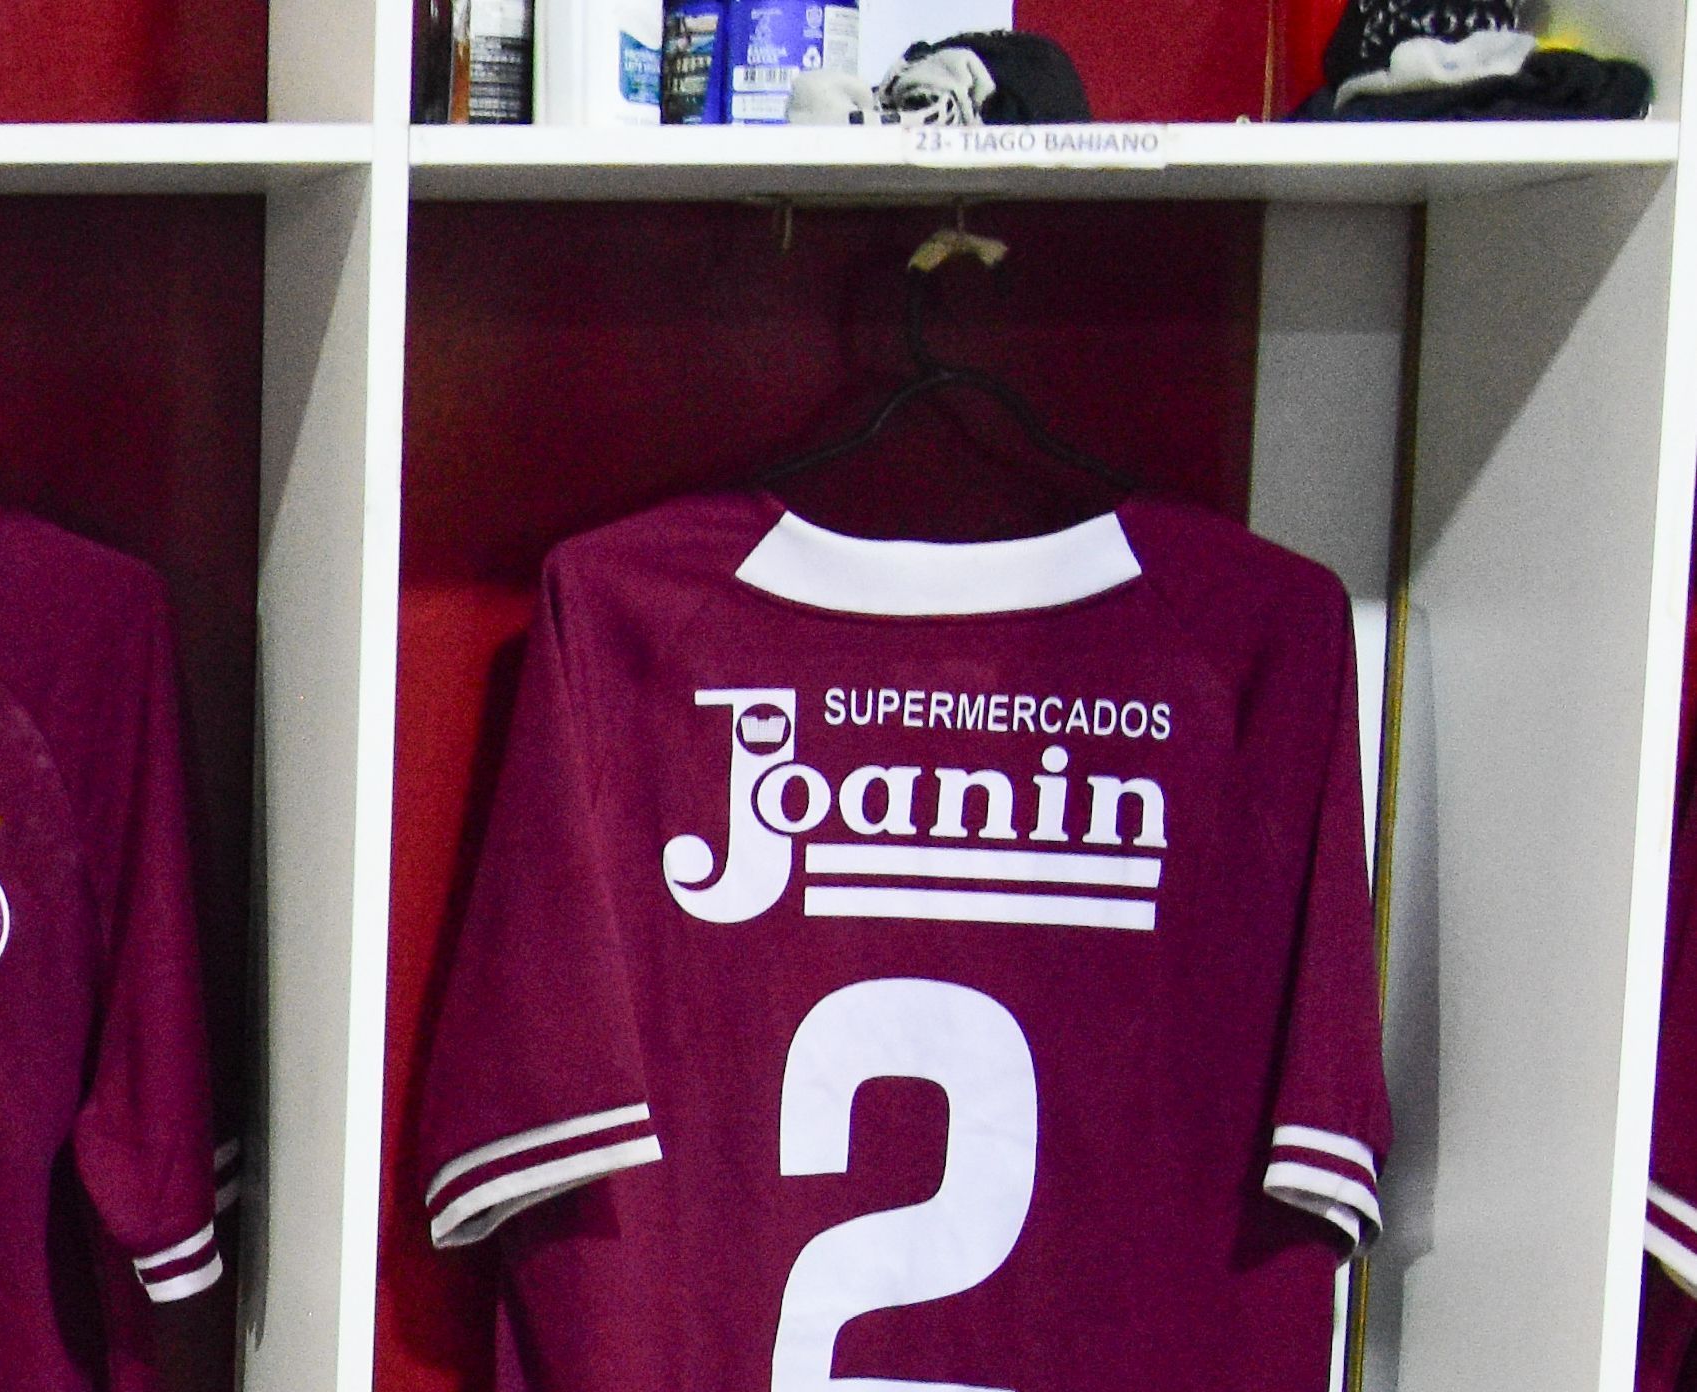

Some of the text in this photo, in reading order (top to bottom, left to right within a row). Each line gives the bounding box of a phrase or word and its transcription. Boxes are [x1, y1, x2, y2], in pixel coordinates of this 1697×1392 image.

[962, 131, 1036, 152] TIAGO
[1044, 132, 1159, 153] BAHIANO
[824, 687, 1171, 740] SUPERMERCADOS
[663, 688, 1167, 924] Joanin
